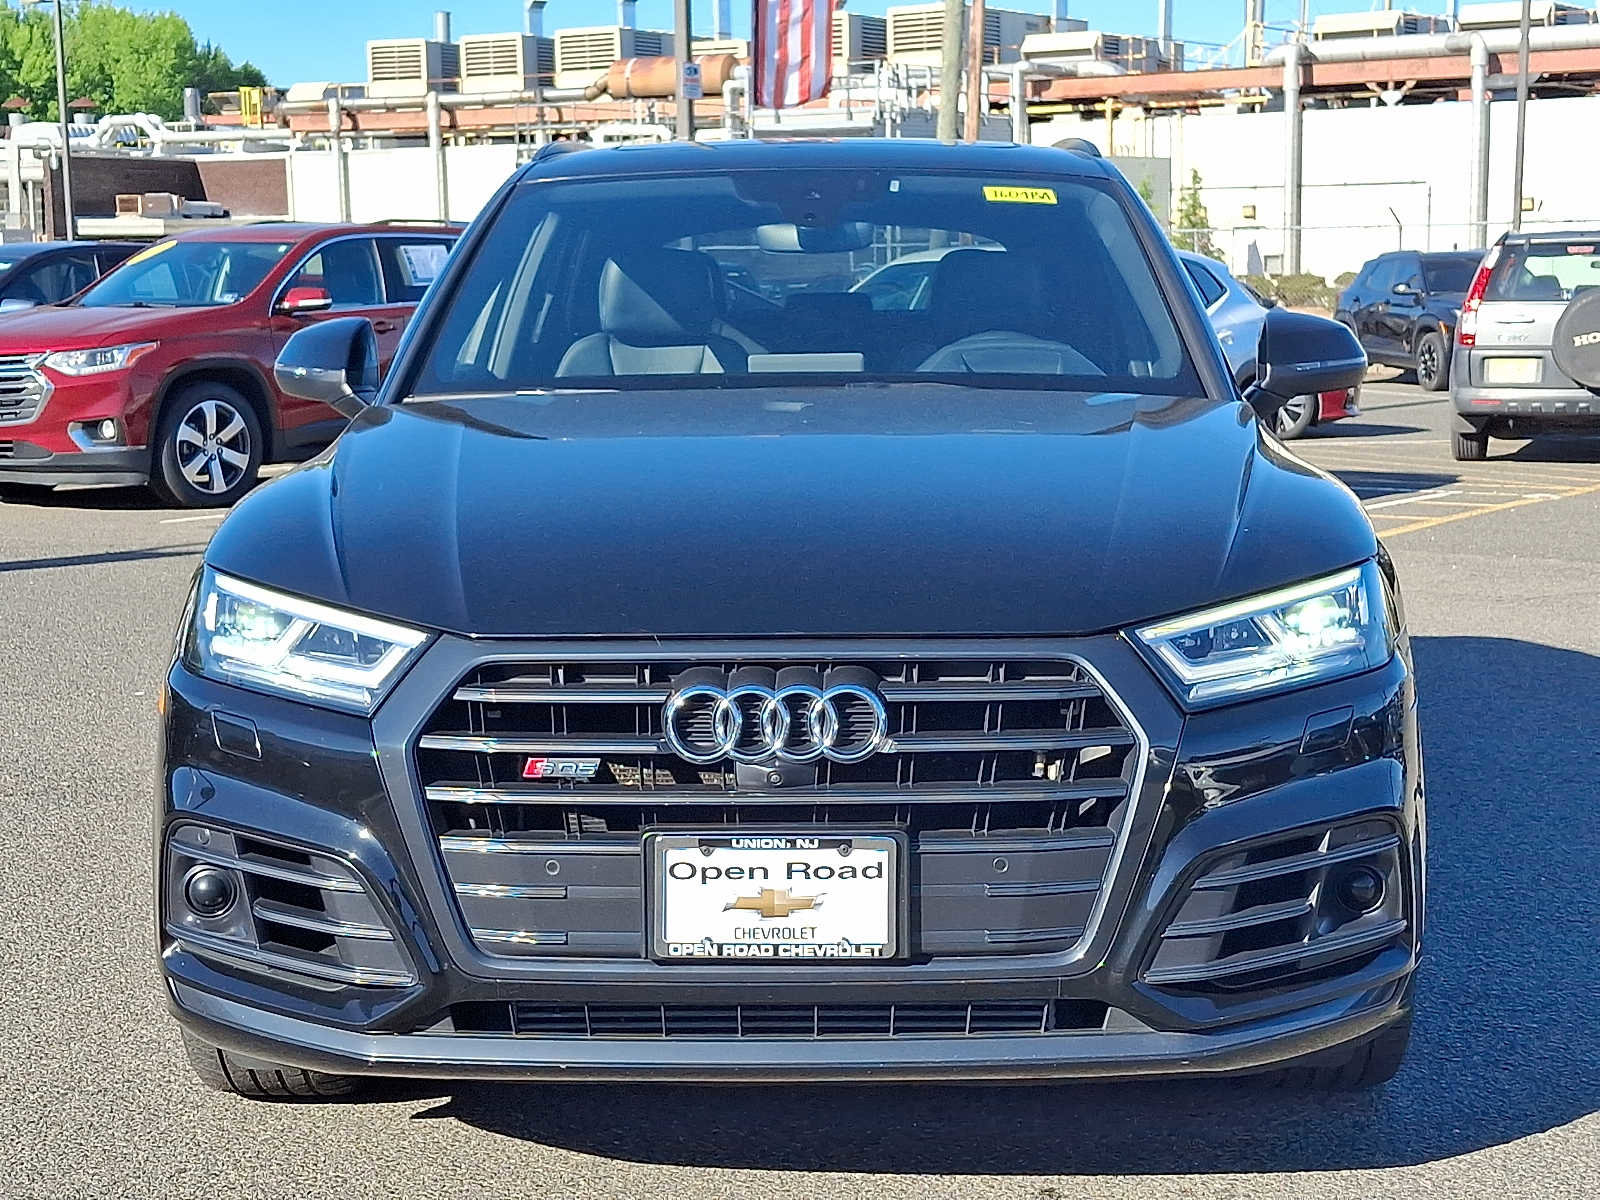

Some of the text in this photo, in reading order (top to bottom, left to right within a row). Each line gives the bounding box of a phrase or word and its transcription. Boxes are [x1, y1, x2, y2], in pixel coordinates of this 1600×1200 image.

[731, 838, 819, 849] UNION, NJ
[669, 862, 883, 884] Open Road
[734, 927, 817, 940] CHEVROLET
[669, 944, 883, 957] OPEN ROAD CHEVROLET
